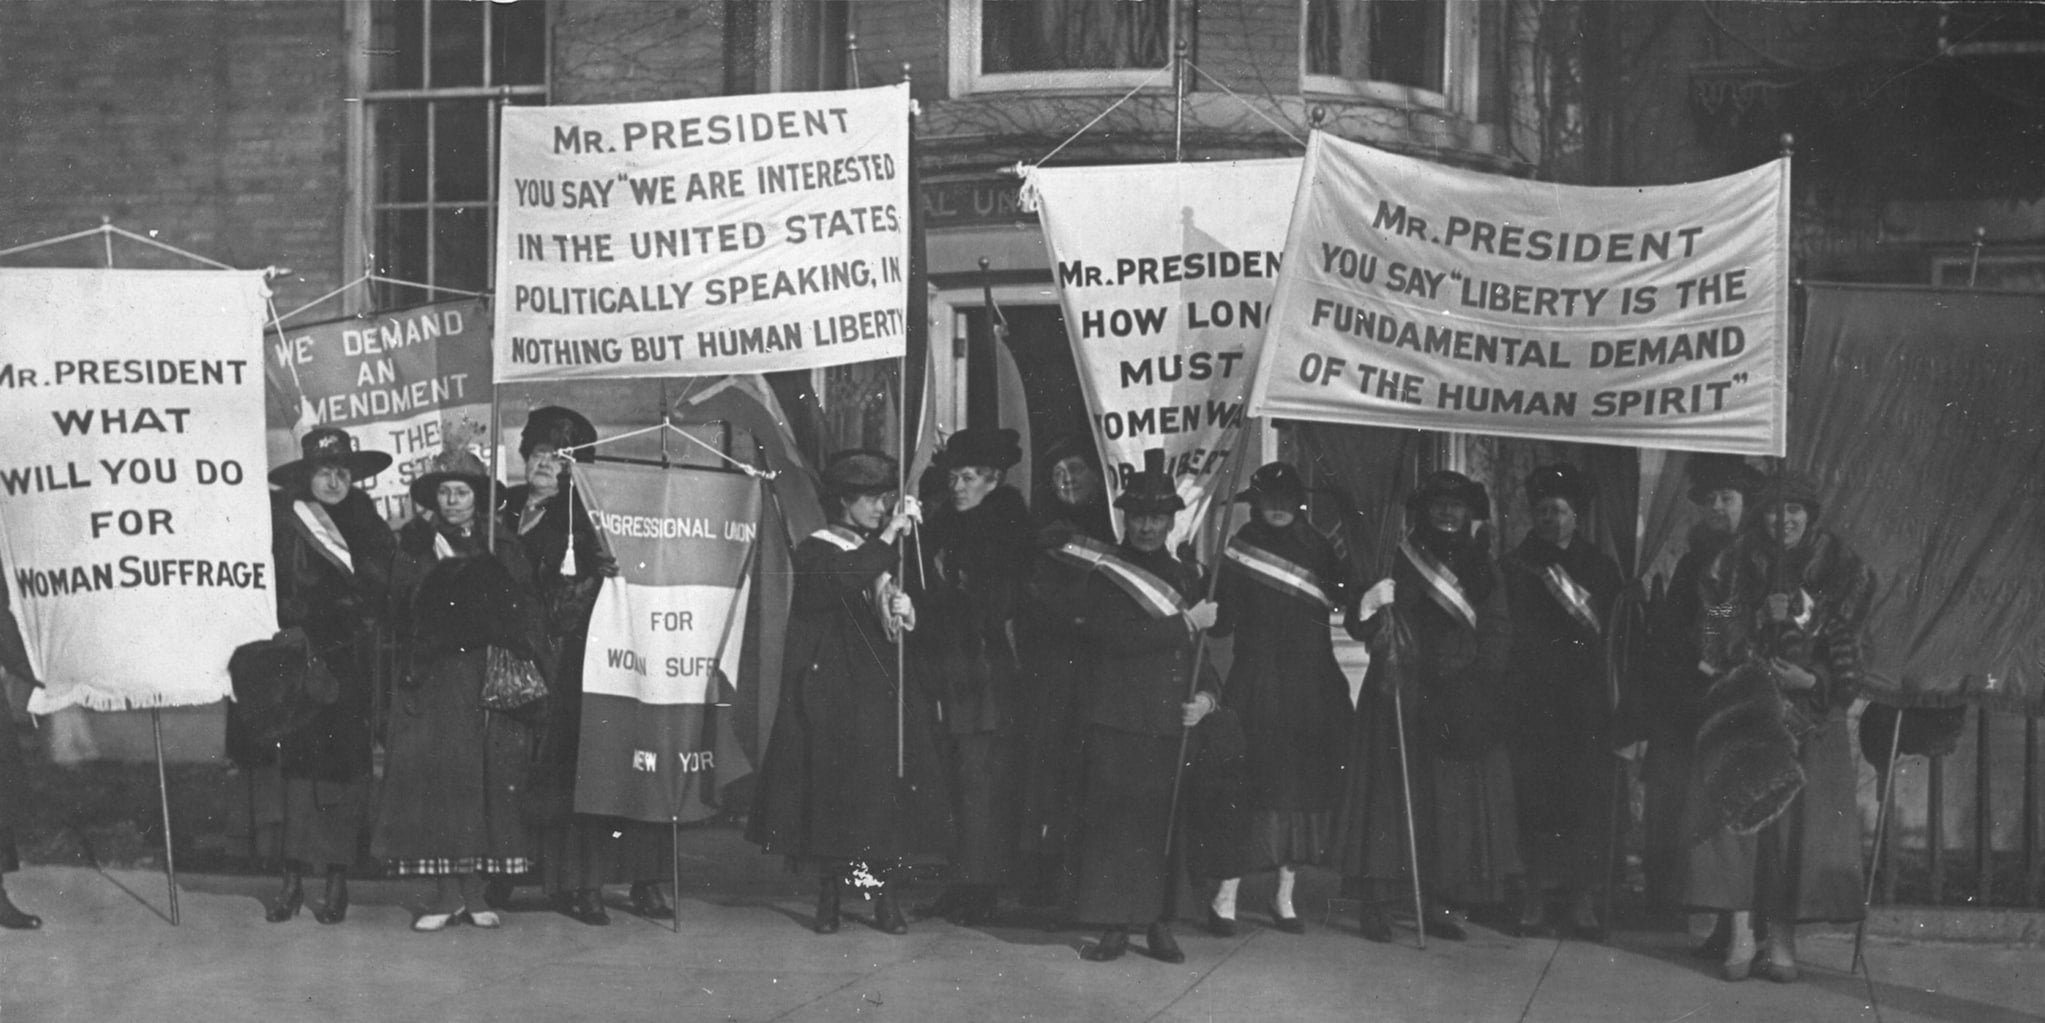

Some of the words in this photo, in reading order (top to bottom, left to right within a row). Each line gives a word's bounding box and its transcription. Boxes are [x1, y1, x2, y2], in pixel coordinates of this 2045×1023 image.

[623, 107, 848, 152] PRESIDENT
[515, 177, 555, 207] YOU
[562, 179, 614, 209] SAY
[686, 168, 745, 201] ARE
[757, 152, 895, 194] INTERESTED
[518, 233, 544, 261] IN
[552, 233, 614, 262] THE
[630, 221, 766, 260] UNITED
[1445, 215, 1703, 263] PRESIDENT
[515, 281, 693, 315] POLITICALLY
[705, 258, 877, 306] SPEAKING,
[882, 256, 901, 283] IN
[1117, 250, 1284, 287] PRESIDEN
[1322, 242, 1377, 284] YOU
[1386, 261, 1447, 300] SAY
[1621, 286, 1658, 316] IS
[1676, 269, 1747, 310] THE
[275, 335, 314, 368] WE
[342, 310, 464, 356] DEMAND
[512, 337, 622, 365] NOTHING
[631, 334, 684, 363] BUT
[697, 322, 802, 358] HUMAN
[813, 307, 904, 347] LIBERTY
[1082, 306, 1168, 339] HOW
[1312, 298, 1571, 369] FUNDAMENTAL
[1589, 326, 1746, 369] DEMAND
[54, 359, 247, 386] PRESIDENT
[357, 358, 396, 388] AN
[1120, 351, 1244, 389] MUST
[1299, 352, 1346, 387] OF
[1358, 363, 1425, 406] THE
[1437, 382, 1578, 417] HUMAN
[295, 373, 468, 425] MENDMENT
[52, 407, 191, 437] WHAT
[389, 420, 441, 454] THE
[0, 461, 91, 497] WILL
[99, 458, 177, 486] YOU
[196, 459, 243, 486] DO
[91, 508, 175, 539] FOR
[16, 563, 114, 598] WOMAN
[119, 555, 267, 590] SUFFRAGE
[651, 611, 693, 633] FOR
[679, 751, 714, 774] YOR
